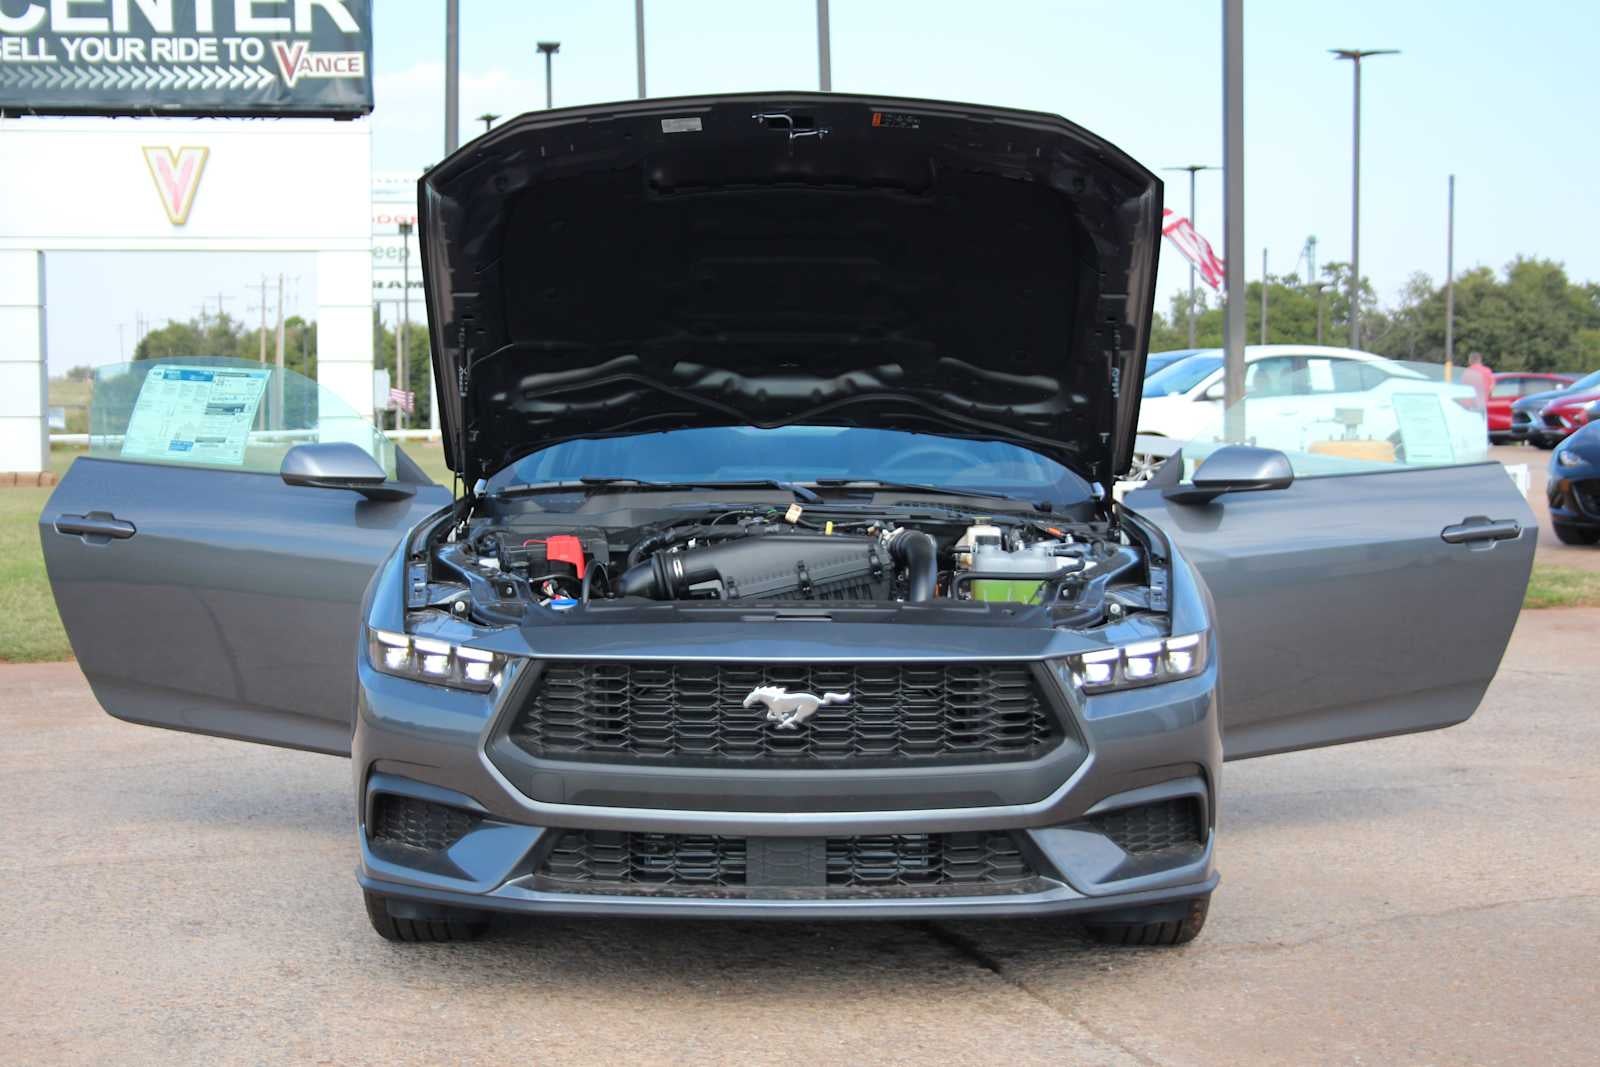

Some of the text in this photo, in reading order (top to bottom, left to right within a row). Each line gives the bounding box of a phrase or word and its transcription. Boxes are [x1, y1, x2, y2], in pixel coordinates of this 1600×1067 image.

[0, 37, 264, 62] ELL YOUR RIDE TO
[271, 40, 360, 87] VANCE
[372, 246, 411, 263] eep
